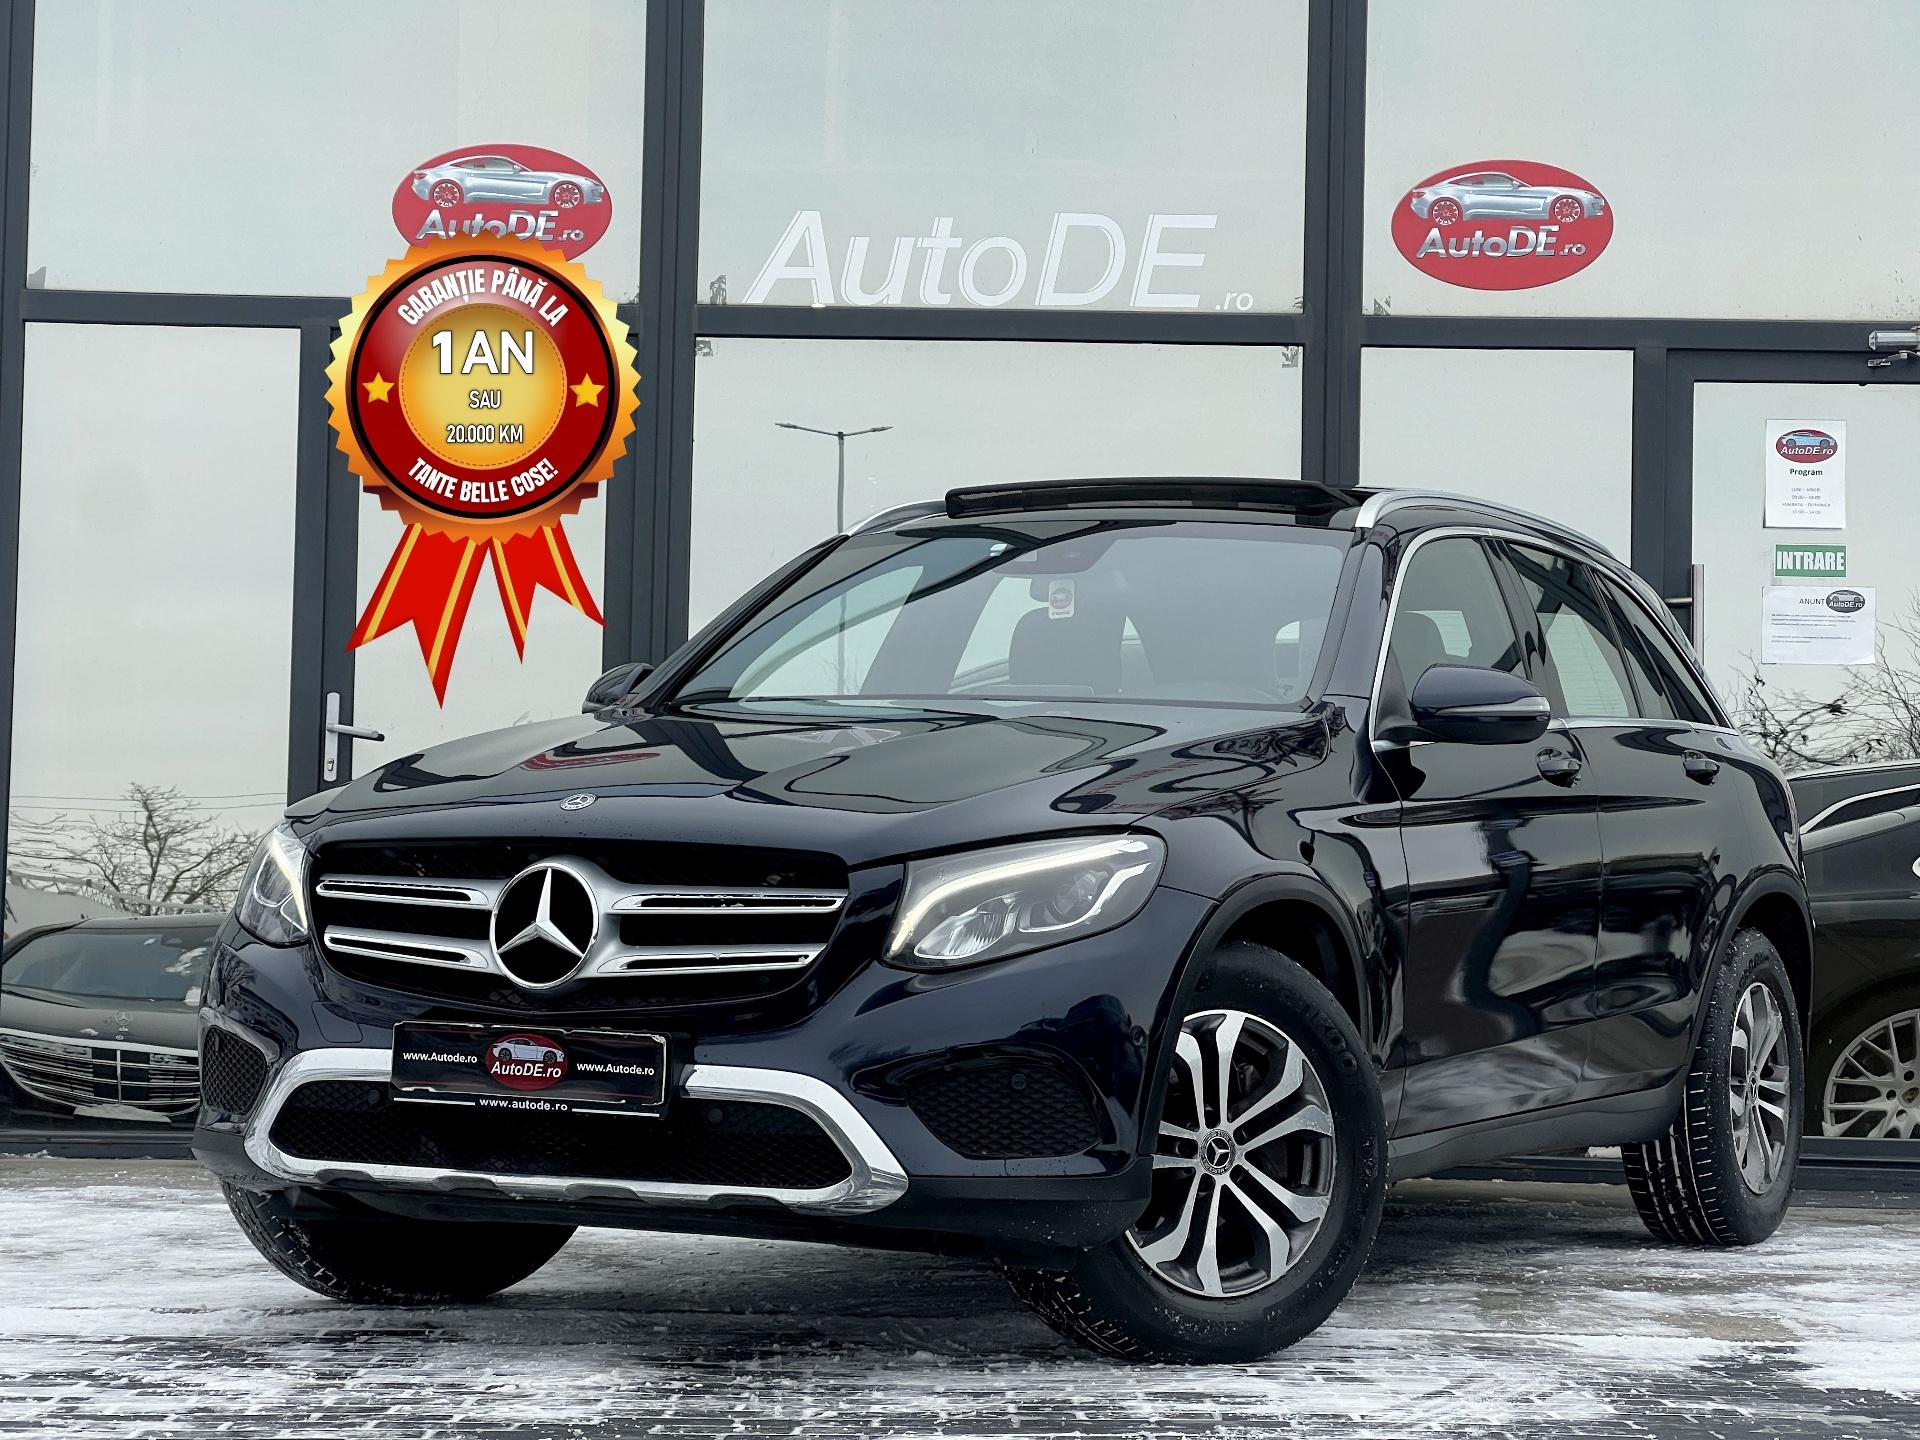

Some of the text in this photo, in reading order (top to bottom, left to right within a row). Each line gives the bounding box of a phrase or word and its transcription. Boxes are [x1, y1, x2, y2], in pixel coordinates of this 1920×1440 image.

[1789, 468, 1823, 477] Program
[1776, 551, 1845, 571] INTRARE
[402, 1050, 478, 1064] www.Autode.ro
[490, 1061, 562, 1078] AutoDE.ro
[576, 1062, 655, 1076] www.Autode.ro
[479, 1097, 568, 1111] www.autode.ro
